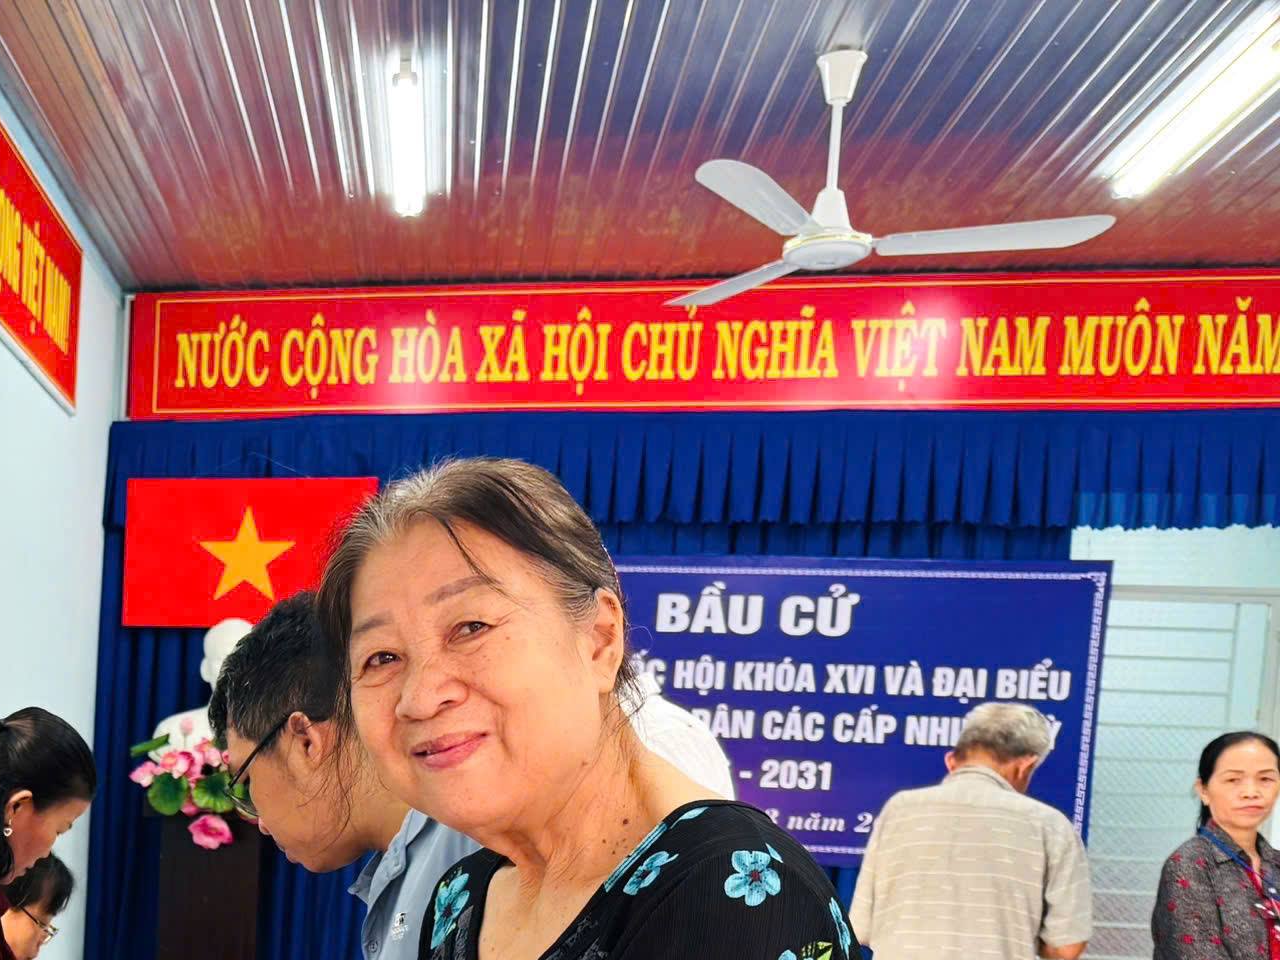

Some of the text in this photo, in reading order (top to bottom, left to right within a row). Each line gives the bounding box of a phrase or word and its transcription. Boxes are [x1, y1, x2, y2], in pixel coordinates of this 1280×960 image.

[22, 220, 45, 334] VIỆT
[43, 255, 71, 355] NAM
[175, 314, 270, 388] NƯỚC
[281, 313, 379, 399] CỘNG
[391, 310, 467, 387] HÒA
[476, 309, 528, 382] XÃ
[540, 306, 611, 395] HỘI
[624, 304, 703, 380] CHỦ
[713, 306, 838, 379] NGHĨA
[851, 301, 948, 392] VIỆT
[956, 315, 1047, 376] NAM
[1061, 297, 1184, 376] MUÔN
[656, 581, 861, 637] BẦU CỬ
[673, 654, 725, 695] HỘI
[733, 656, 816, 693] KHÓA
[823, 664, 875, 694] XVI
[884, 661, 924, 696] VÀ
[932, 666, 988, 704] ĐẠI
[995, 658, 1072, 701] BIỂU
[762, 706, 825, 742] CÁC
[833, 704, 897, 744] CẤP
[904, 715, 966, 747] NHI
[760, 759, 832, 790] 2031
[787, 812, 845, 832] năm
